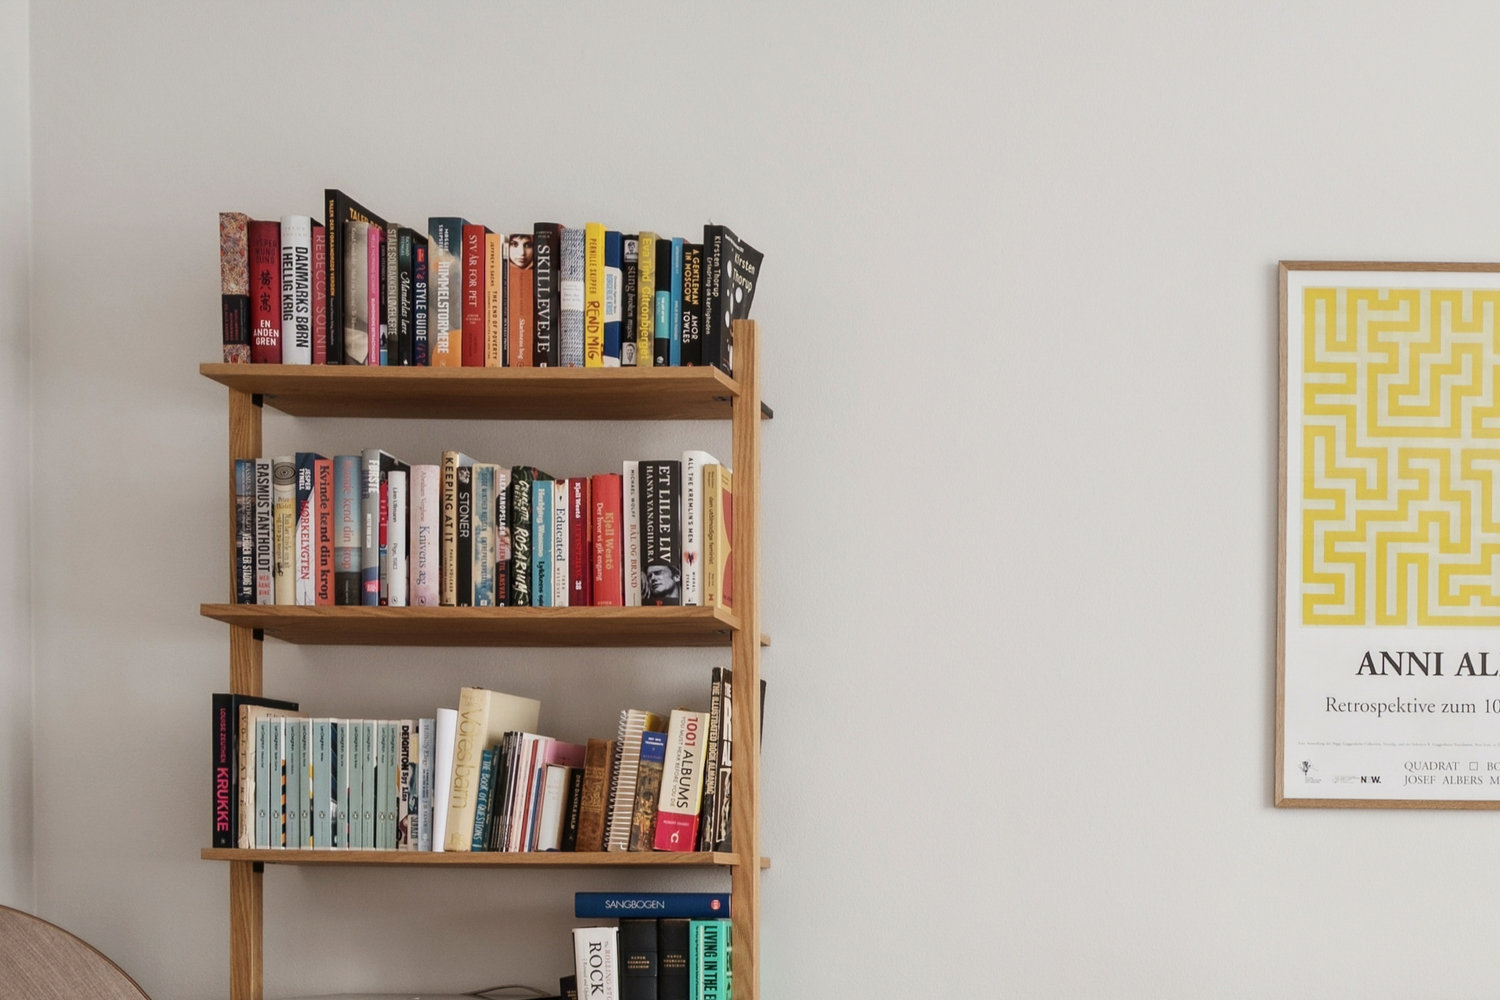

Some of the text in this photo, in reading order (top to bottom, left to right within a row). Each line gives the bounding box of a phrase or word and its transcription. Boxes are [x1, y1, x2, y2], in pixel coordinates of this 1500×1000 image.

[283, 253, 292, 291] HELLIG
[469, 234, 479, 308] SYV ÅR FOR PET
[589, 238, 597, 294] PERNILLE SKIPPER
[685, 252, 691, 260] IN
[712, 235, 721, 297] Kirsten Thorup
[734, 253, 755, 275] Kirsten
[295, 246, 308, 348] DANMARKS BØRN
[387, 229, 398, 335] STÅLE SOLBAKKEN LØVEHJERTE
[400, 272, 412, 335] Mandelas lære
[537, 244, 550, 353] SKILLEVEJE
[640, 238, 652, 359] Eva Tind Citronbjerget
[691, 257, 699, 305] GENTLEMAN
[732, 273, 753, 293] Thorup
[260, 320, 271, 328] EN
[283, 294, 293, 321] KRIG
[415, 282, 426, 341] STYLE GUIDE
[437, 262, 449, 354] HIMMELSTORMERE
[586, 300, 600, 360] REND MIG
[683, 311, 691, 343] TOWLES
[253, 328, 279, 337] ANDEN
[255, 337, 276, 346] GREN
[368, 459, 380, 494] FØRSTE
[257, 463, 270, 572] RASMUS TANTHOLDT
[343, 498, 353, 522] kend
[444, 457, 453, 543] KEEPING AT IT
[459, 492, 469, 538] STONER
[520, 480, 530, 522] CHARLOTTE
[646, 465, 654, 563] HANYA YANAGIHARA
[658, 465, 671, 563] ET LILLE LIV
[300, 499, 310, 580] MØRKELYGTEN
[319, 465, 330, 600] Kvinde kend din krop
[343, 526, 353, 542] din
[419, 525, 430, 568] Knivens
[555, 508, 565, 562] Educated
[595, 503, 604, 582] Der hvor vi gik engang
[603, 512, 614, 570] Kjell Westö
[629, 524, 639, 542] BÅL
[631, 544, 637, 557] OG
[341, 547, 352, 569] krop
[417, 570, 427, 585] æg
[514, 527, 529, 593] ROSARIUM
[1355, 651, 1445, 677] ANNI
[1325, 696, 1436, 717] Retrospektive
[1441, 702, 1477, 715] zum
[401, 725, 409, 770] DEIGHTON
[676, 716, 698, 809] 1001 ALBUMS
[1403, 761, 1460, 773] QUADRAT
[672, 762, 680, 783] BEFORE
[1403, 775, 1436, 787] JOSEF
[1441, 775, 1484, 786] ALBERS
[216, 767, 229, 832] KRUKKE
[473, 760, 491, 840] THE BOOK OF QUESTIONS
[605, 899, 665, 909] SANGBOGEN
[703, 925, 717, 958] LIVING
[588, 942, 604, 996] ROCK
[703, 972, 718, 991] THE
[704, 961, 717, 971] IN
